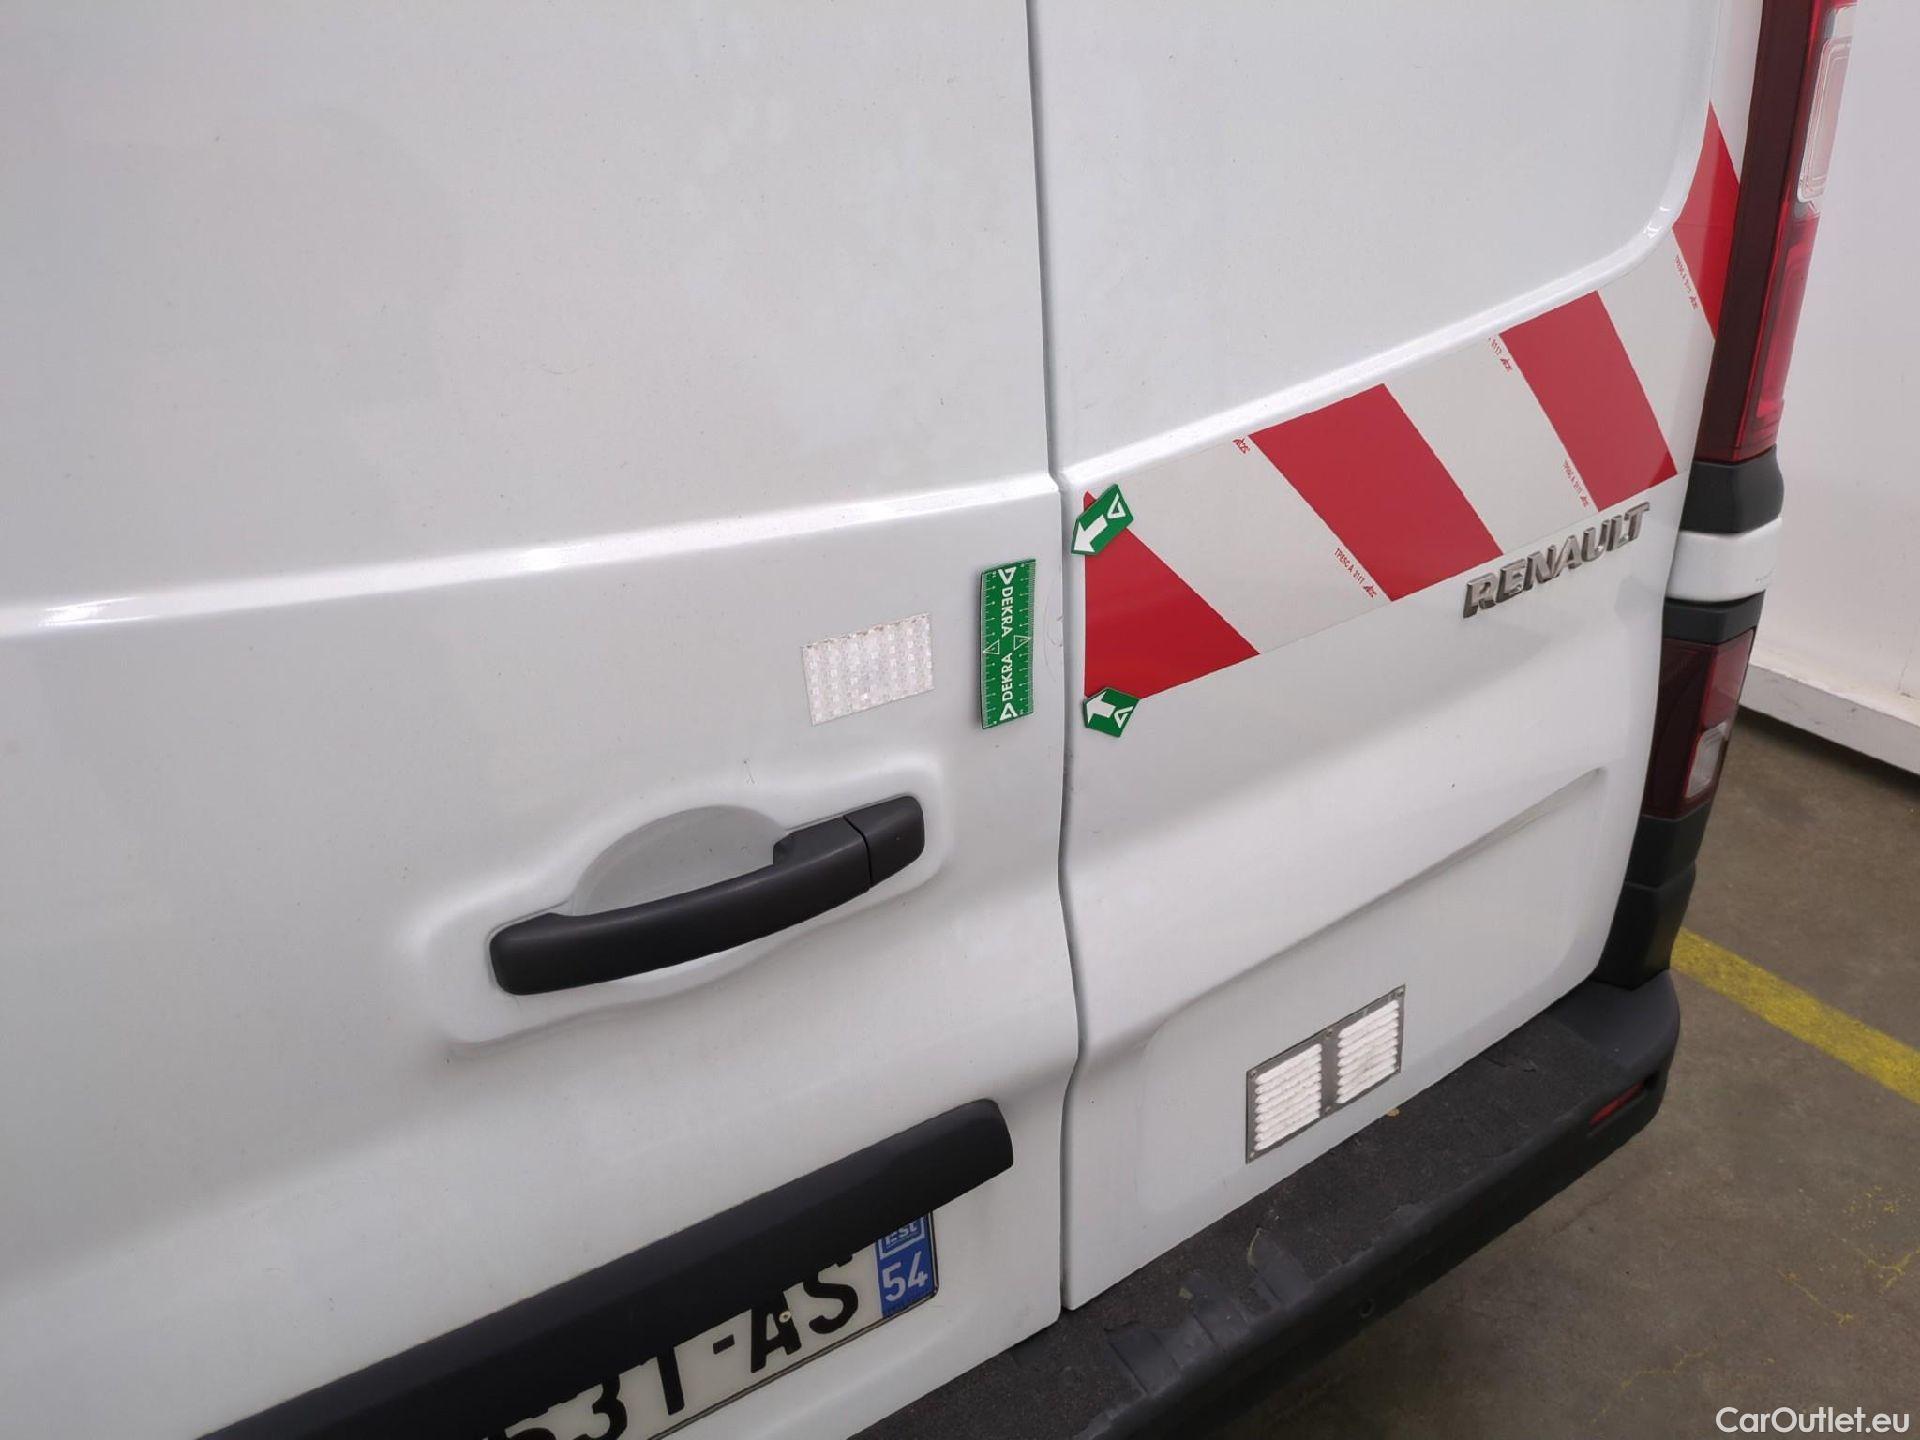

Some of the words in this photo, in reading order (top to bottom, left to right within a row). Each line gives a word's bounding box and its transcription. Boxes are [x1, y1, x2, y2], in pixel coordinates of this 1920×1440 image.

[1463, 501, 1651, 618] RENAULT
[1001, 586, 1014, 638] DEKRA
[1001, 652, 1014, 702] DEKRA
[882, 1250, 928, 1302] 54
